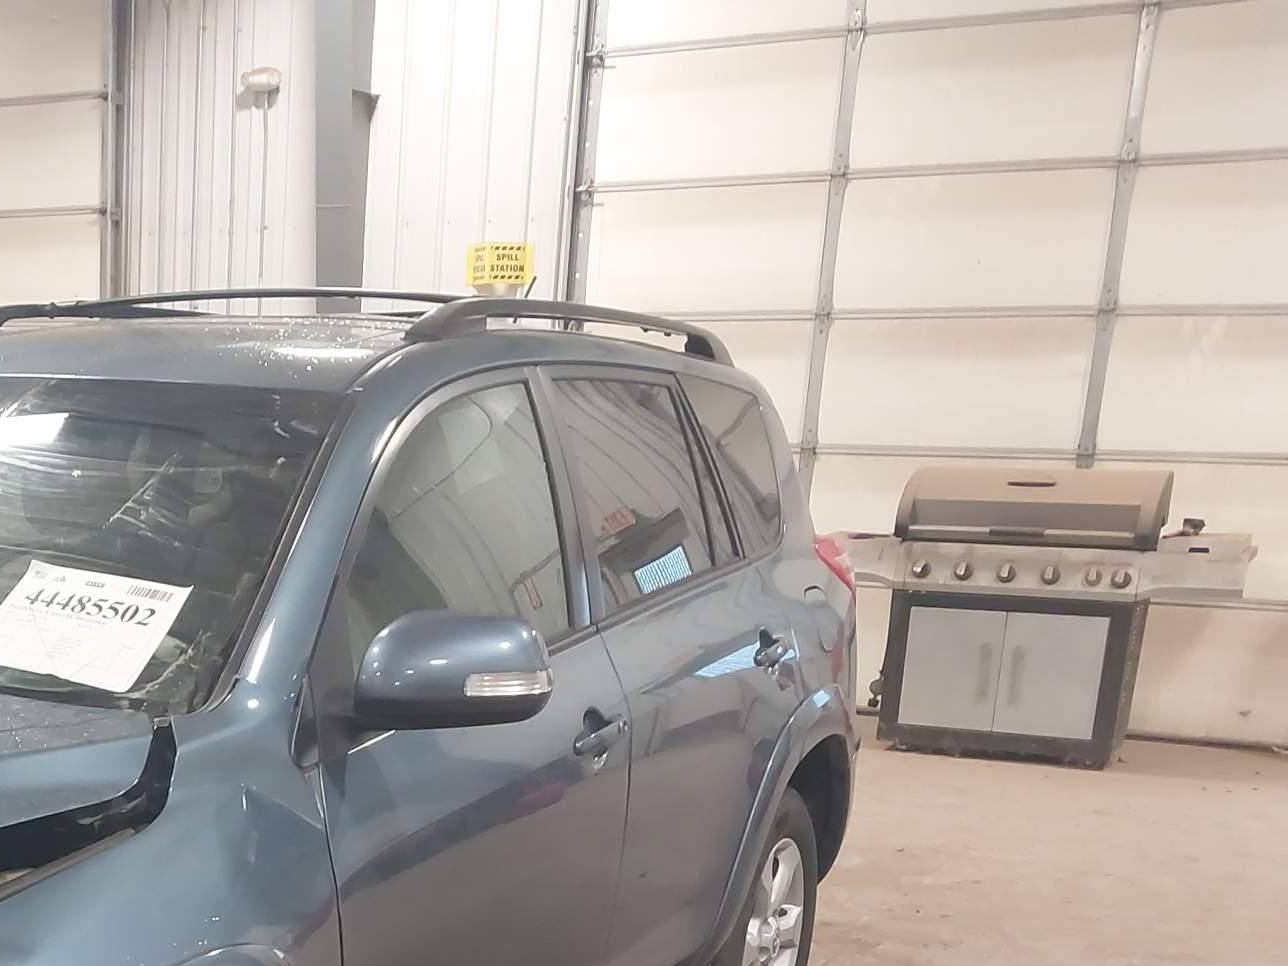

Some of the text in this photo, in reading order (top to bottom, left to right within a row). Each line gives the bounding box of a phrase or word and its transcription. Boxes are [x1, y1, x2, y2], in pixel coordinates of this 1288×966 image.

[496, 253, 519, 261] SPILL
[490, 264, 525, 272] STATION
[24, 588, 157, 627] 44485502
